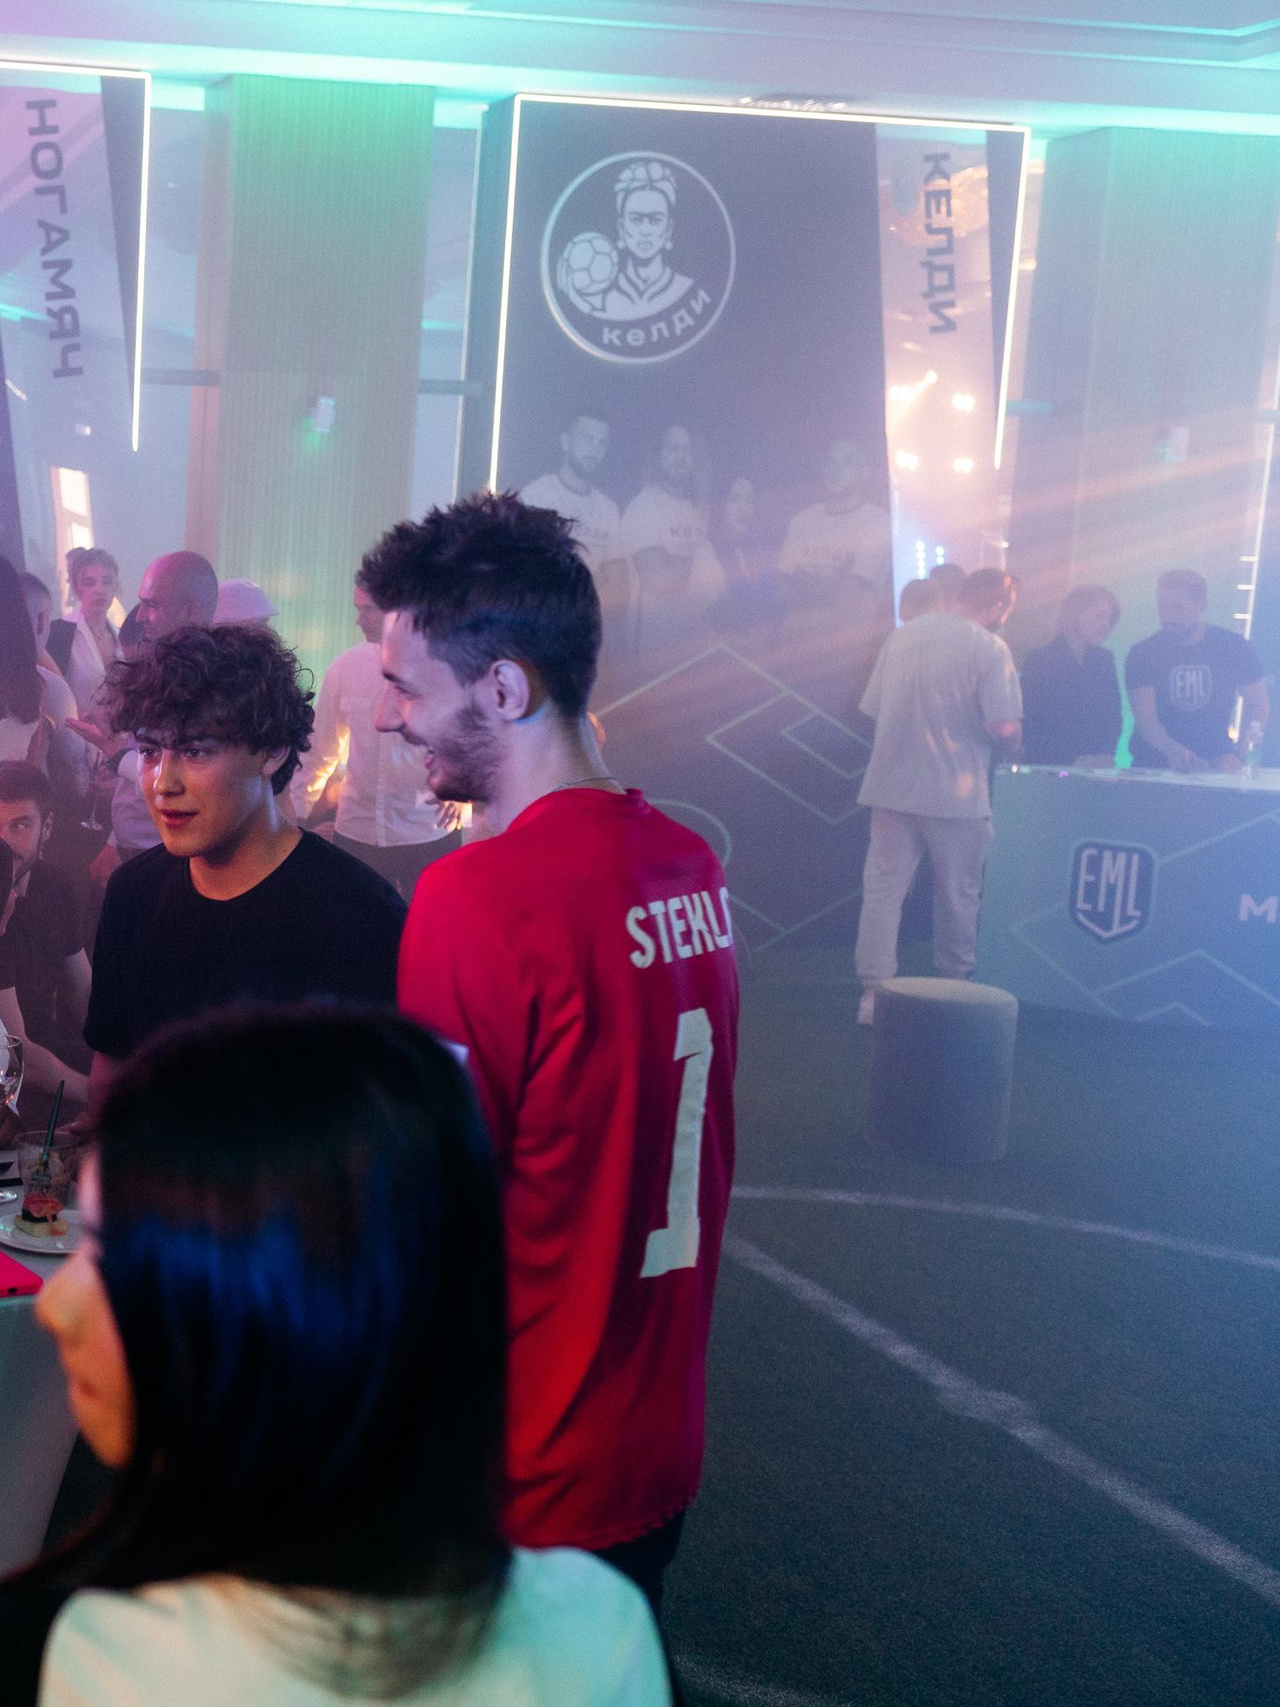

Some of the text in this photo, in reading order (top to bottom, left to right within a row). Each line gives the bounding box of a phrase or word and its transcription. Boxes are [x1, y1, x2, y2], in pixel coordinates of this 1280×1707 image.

[25, 98, 84, 379] НОГАМЯЧ
[920, 152, 957, 334] КЕЛДИ
[1176, 669, 1208, 700] EML
[1076, 847, 1142, 932] EML
[639, 1007, 714, 1279] 1
